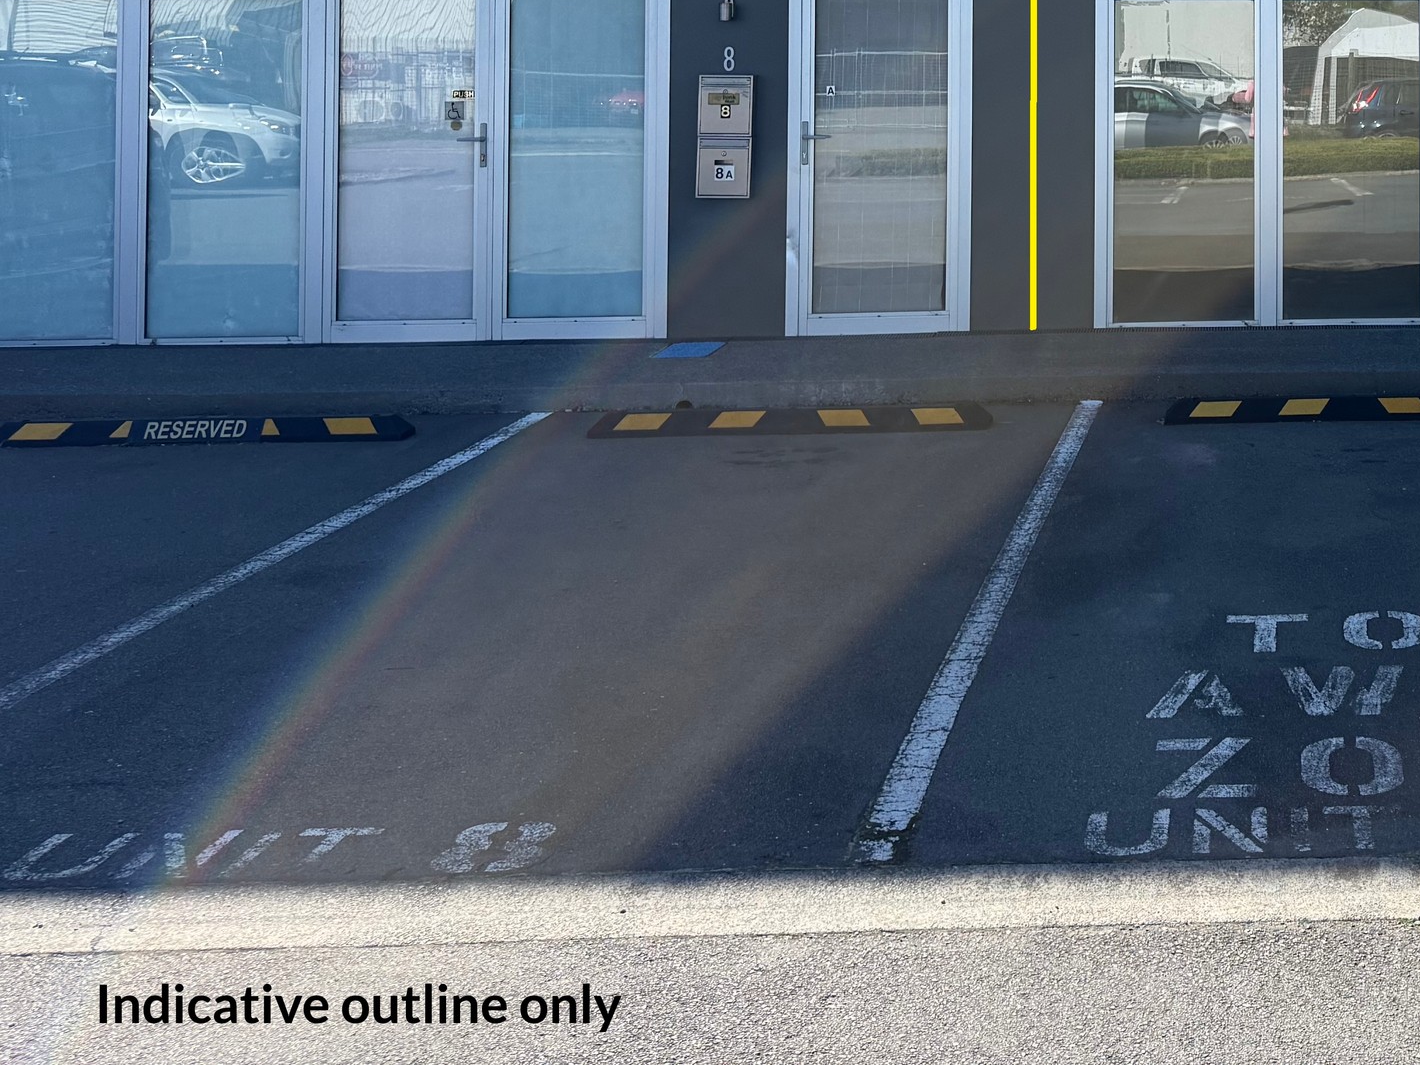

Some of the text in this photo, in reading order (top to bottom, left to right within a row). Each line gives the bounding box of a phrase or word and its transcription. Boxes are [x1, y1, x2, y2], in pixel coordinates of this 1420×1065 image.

[723, 46, 735, 72] 8
[453, 90, 474, 98] PUSH
[827, 87, 835, 95] A
[721, 105, 730, 117] 8
[143, 420, 248, 440] RESERVED
[1083, 804, 1398, 857] UNIT
[2, 821, 557, 882] UNIT 8
